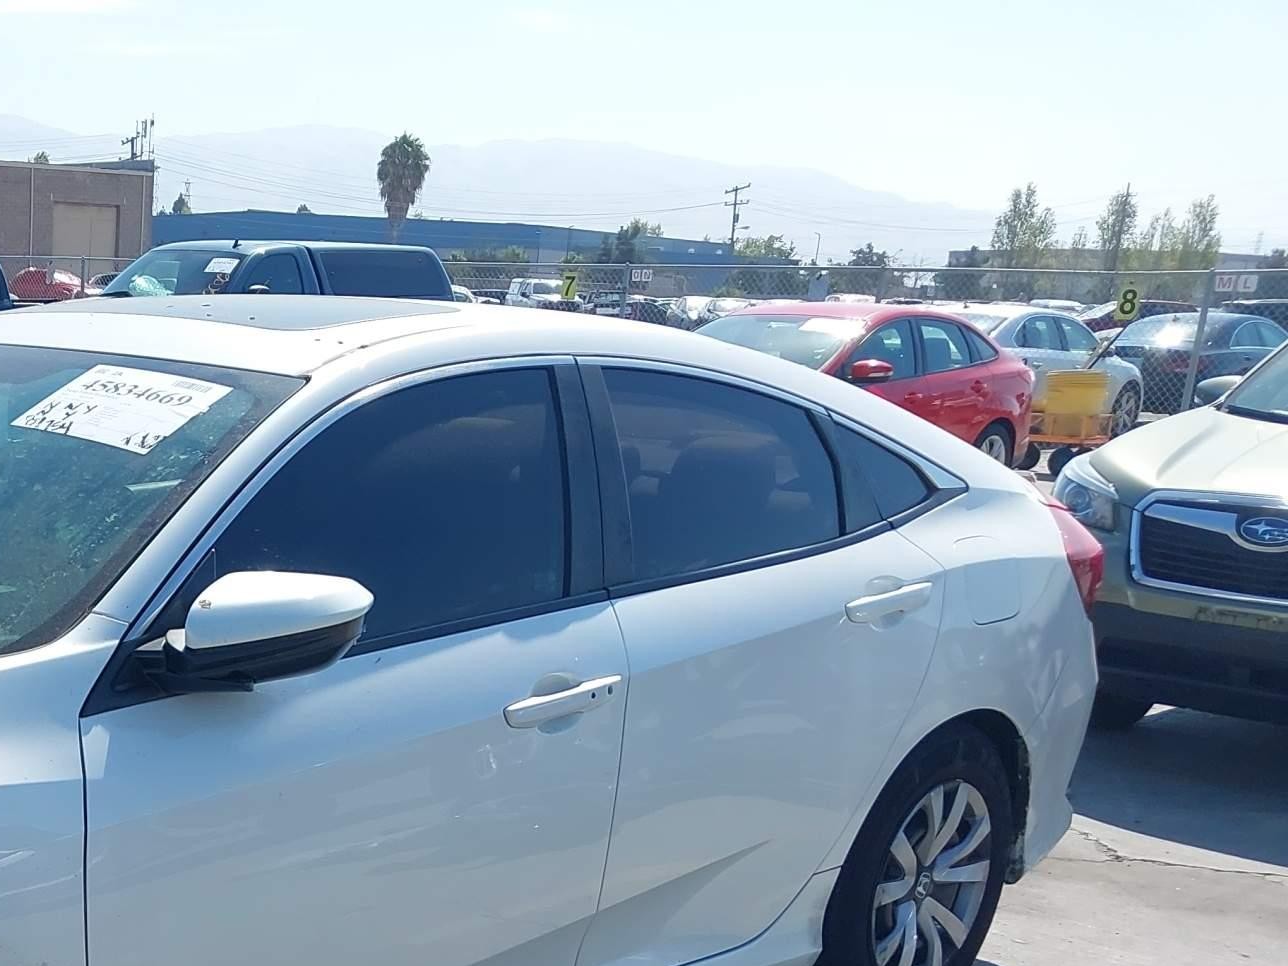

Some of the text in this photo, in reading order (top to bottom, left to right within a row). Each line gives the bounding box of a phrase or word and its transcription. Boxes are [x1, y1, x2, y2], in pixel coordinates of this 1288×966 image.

[565, 275, 576, 297] 7
[1216, 276, 1253, 290] M L
[1118, 288, 1138, 315] 8
[81, 379, 193, 407] 45834669
